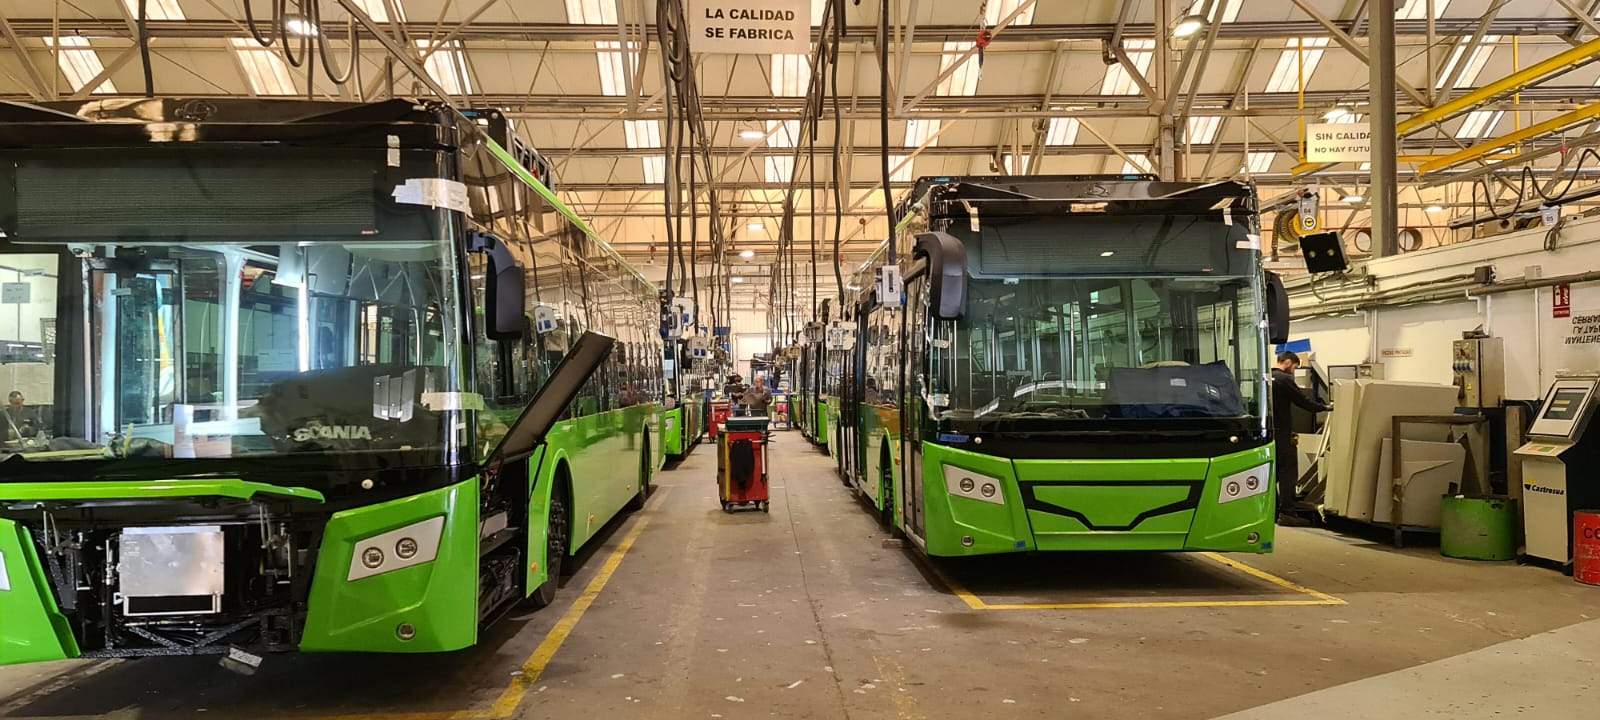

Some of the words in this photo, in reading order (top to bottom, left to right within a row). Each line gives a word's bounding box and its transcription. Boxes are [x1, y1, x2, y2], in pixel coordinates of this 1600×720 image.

[705, 8, 724, 19] LA
[729, 8, 795, 21] CALIDAD
[705, 27, 724, 38] SE
[729, 28, 795, 40] FABRICA
[294, 424, 372, 441] SCANIA
[1532, 484, 1564, 495] Castrosua
